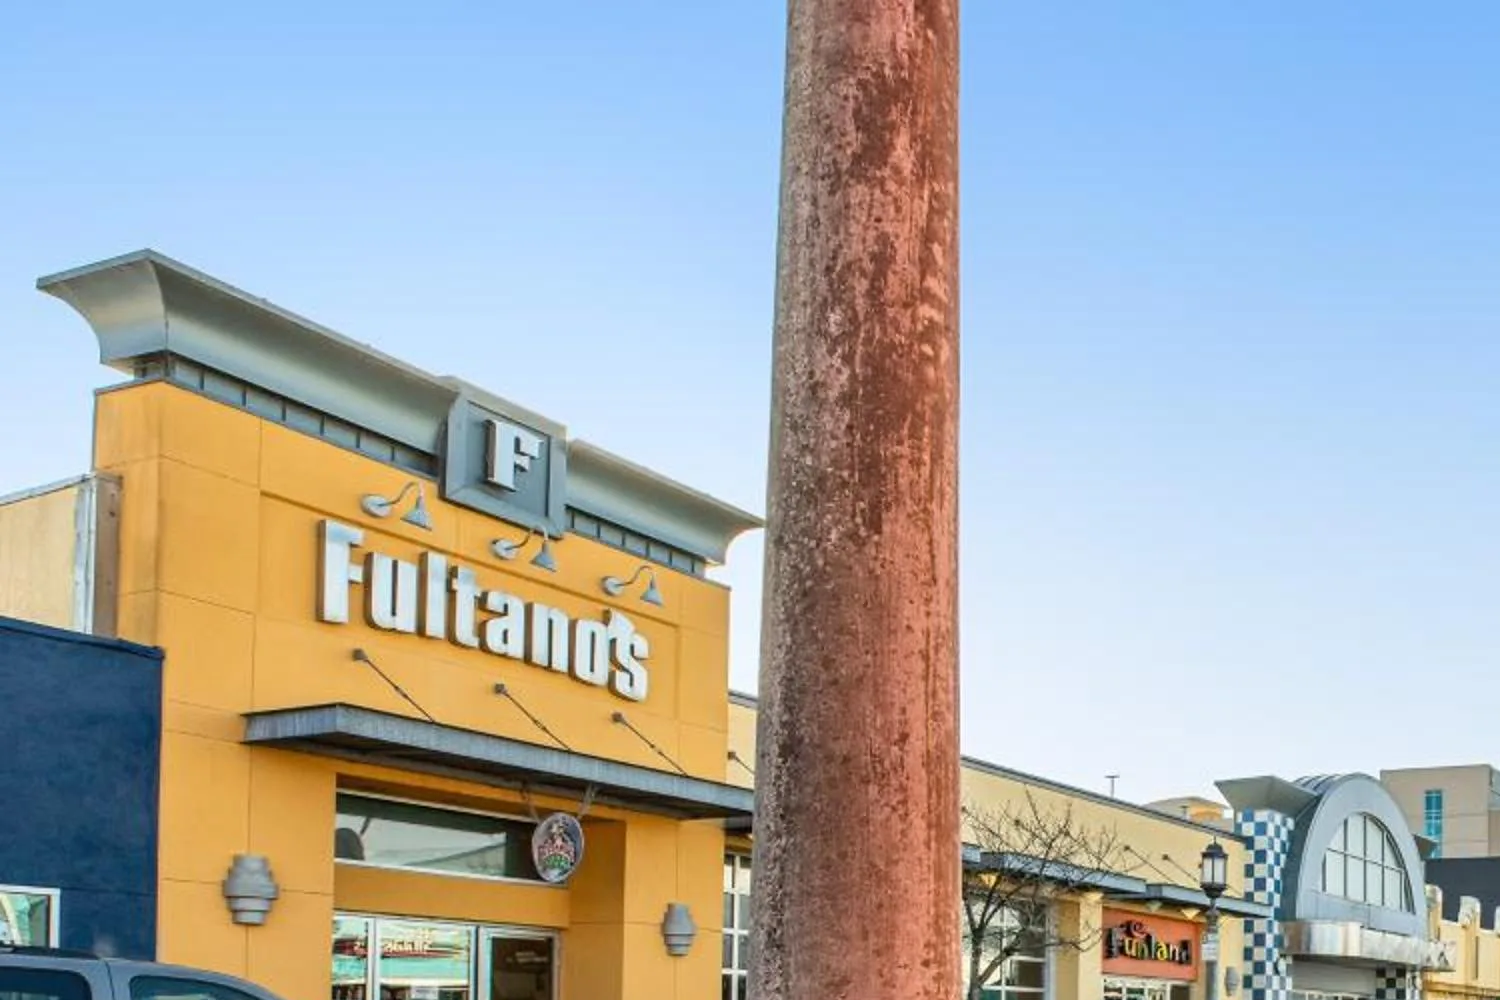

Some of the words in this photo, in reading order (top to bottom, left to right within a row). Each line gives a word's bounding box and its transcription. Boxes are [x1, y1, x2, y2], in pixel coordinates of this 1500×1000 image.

[485, 420, 542, 488] F
[316, 519, 649, 701] Fultano's
[1105, 924, 1192, 964] Funland
